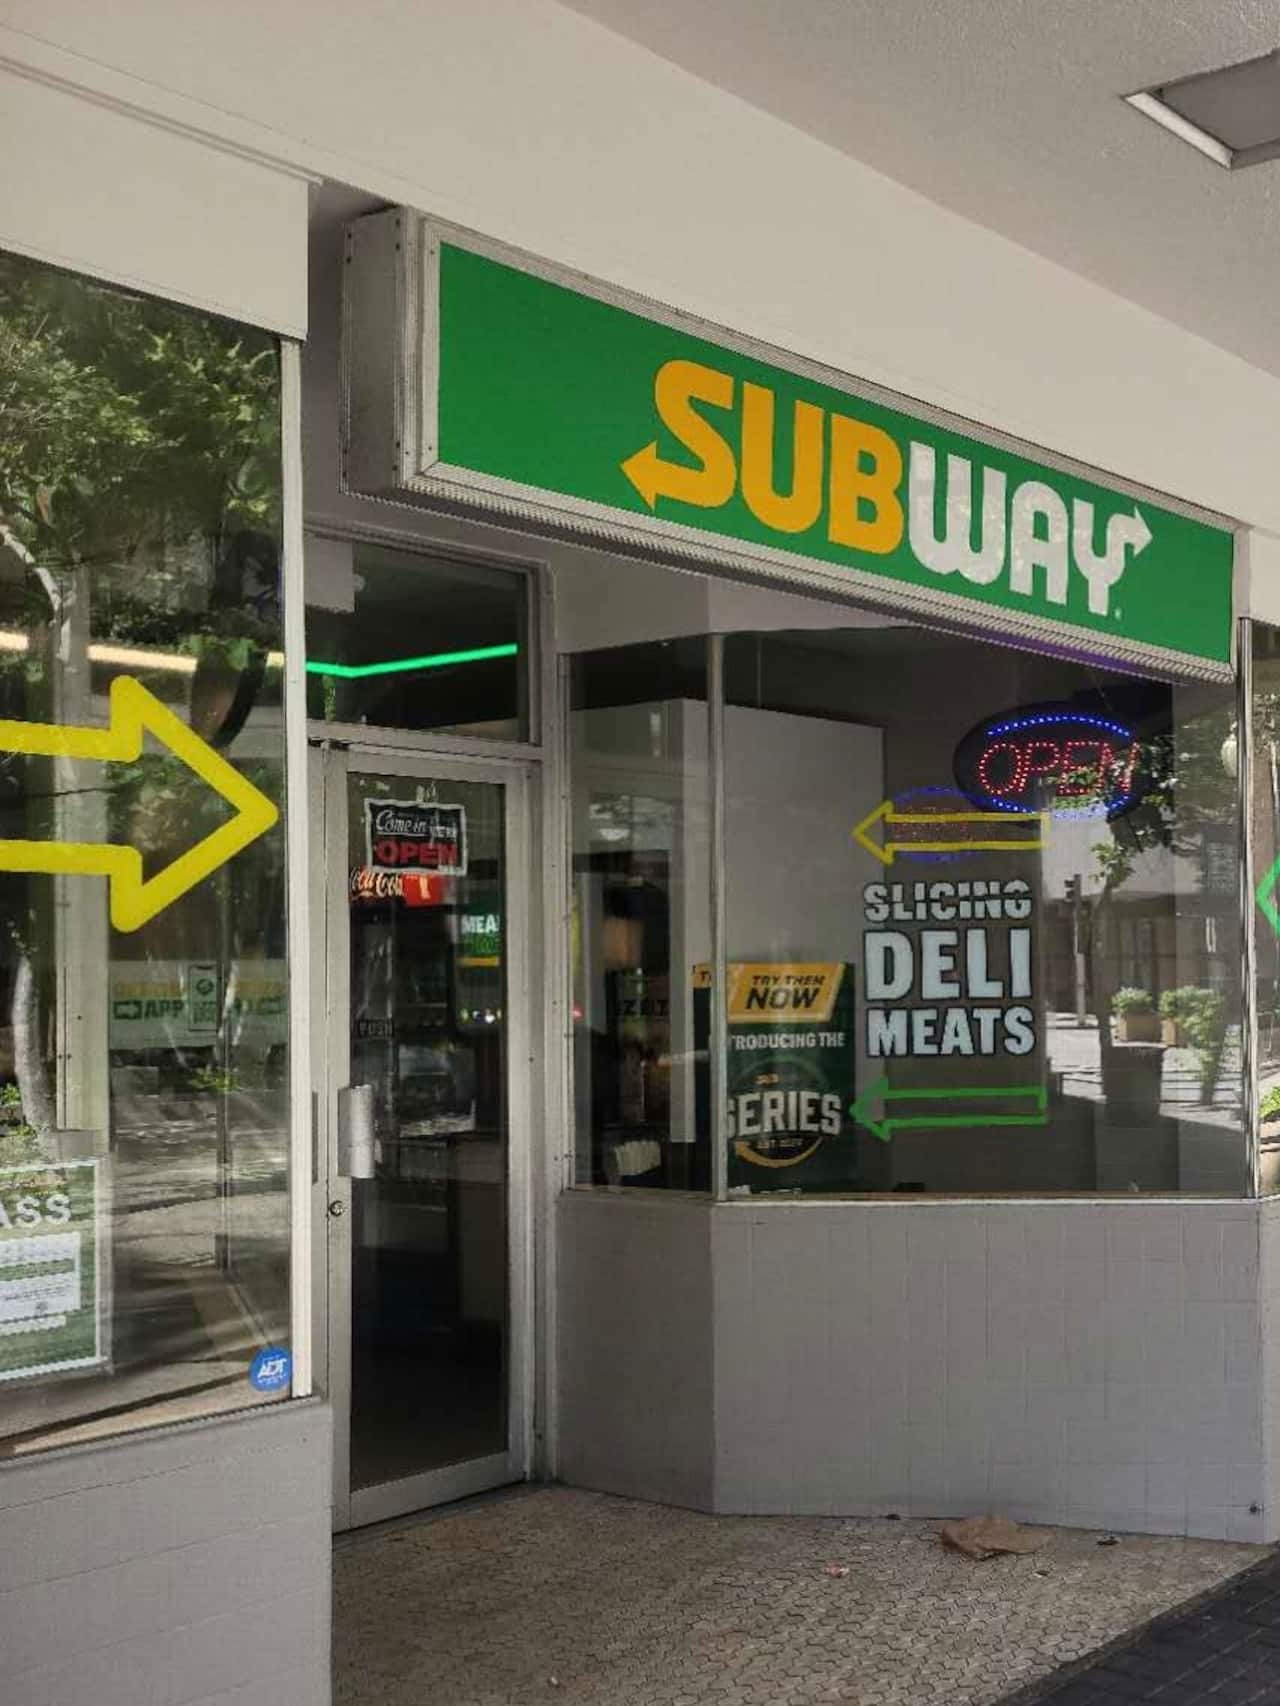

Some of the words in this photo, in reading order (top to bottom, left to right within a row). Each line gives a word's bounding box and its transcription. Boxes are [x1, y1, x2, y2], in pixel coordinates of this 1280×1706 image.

[620, 359, 1153, 618] SUBWAY
[979, 741, 1140, 795] OPEN
[375, 809, 411, 833] Come
[375, 839, 458, 865] OPEN
[863, 879, 1032, 922] SLICING
[461, 914, 499, 933] MEA
[863, 928, 1032, 1001] DELI
[752, 975, 780, 986] TRY
[785, 975, 826, 986] THEM
[745, 987, 820, 1010] NOW
[818, 1032, 847, 1047] THE
[866, 1006, 1035, 1058] MEATS
[257, 1358, 287, 1378] ADT
